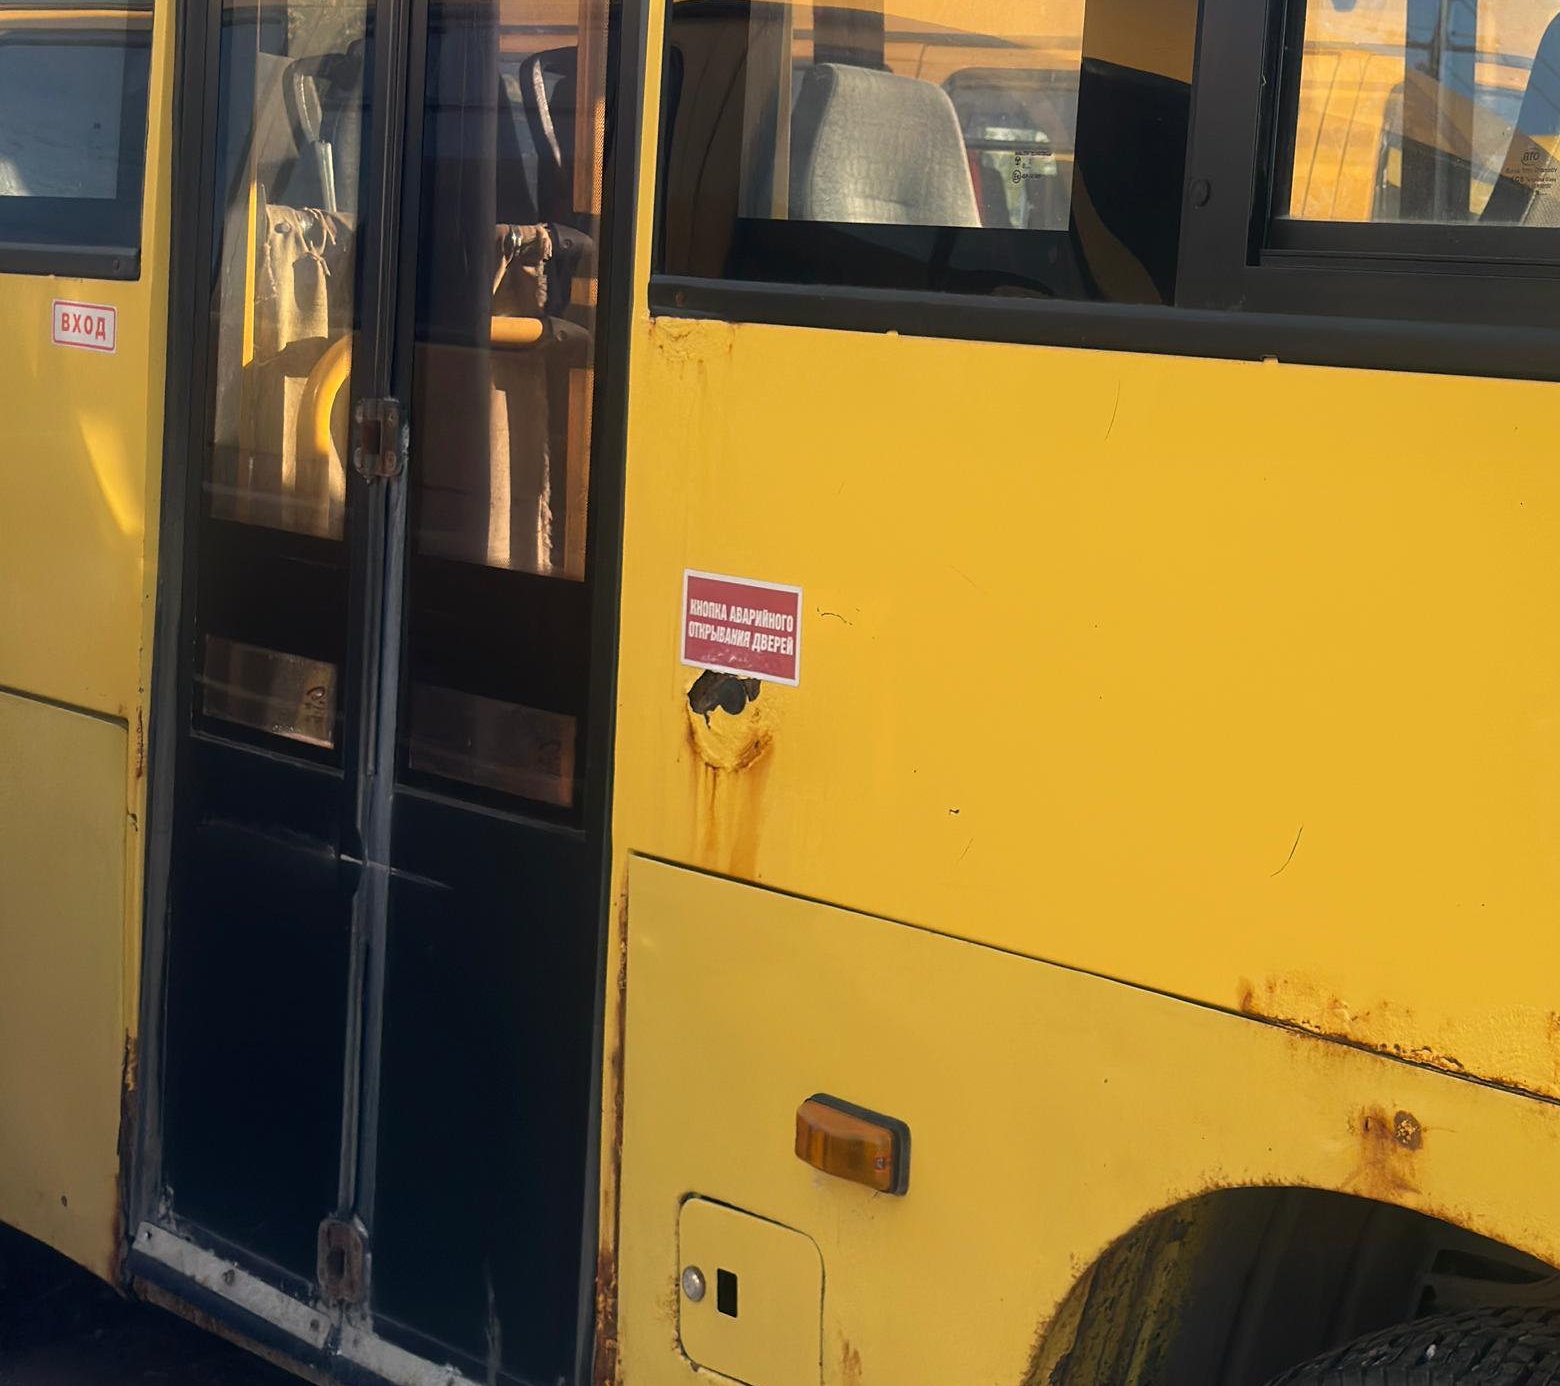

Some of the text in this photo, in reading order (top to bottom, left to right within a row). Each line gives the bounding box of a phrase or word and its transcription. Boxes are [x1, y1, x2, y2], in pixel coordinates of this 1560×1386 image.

[61, 312, 106, 341] ВХОД
[689, 598, 794, 632] КНОПКА АВАРИЙНОГО
[688, 621, 794, 656] ОТКРЫВАНИЯ ДВЕРЕЙ
